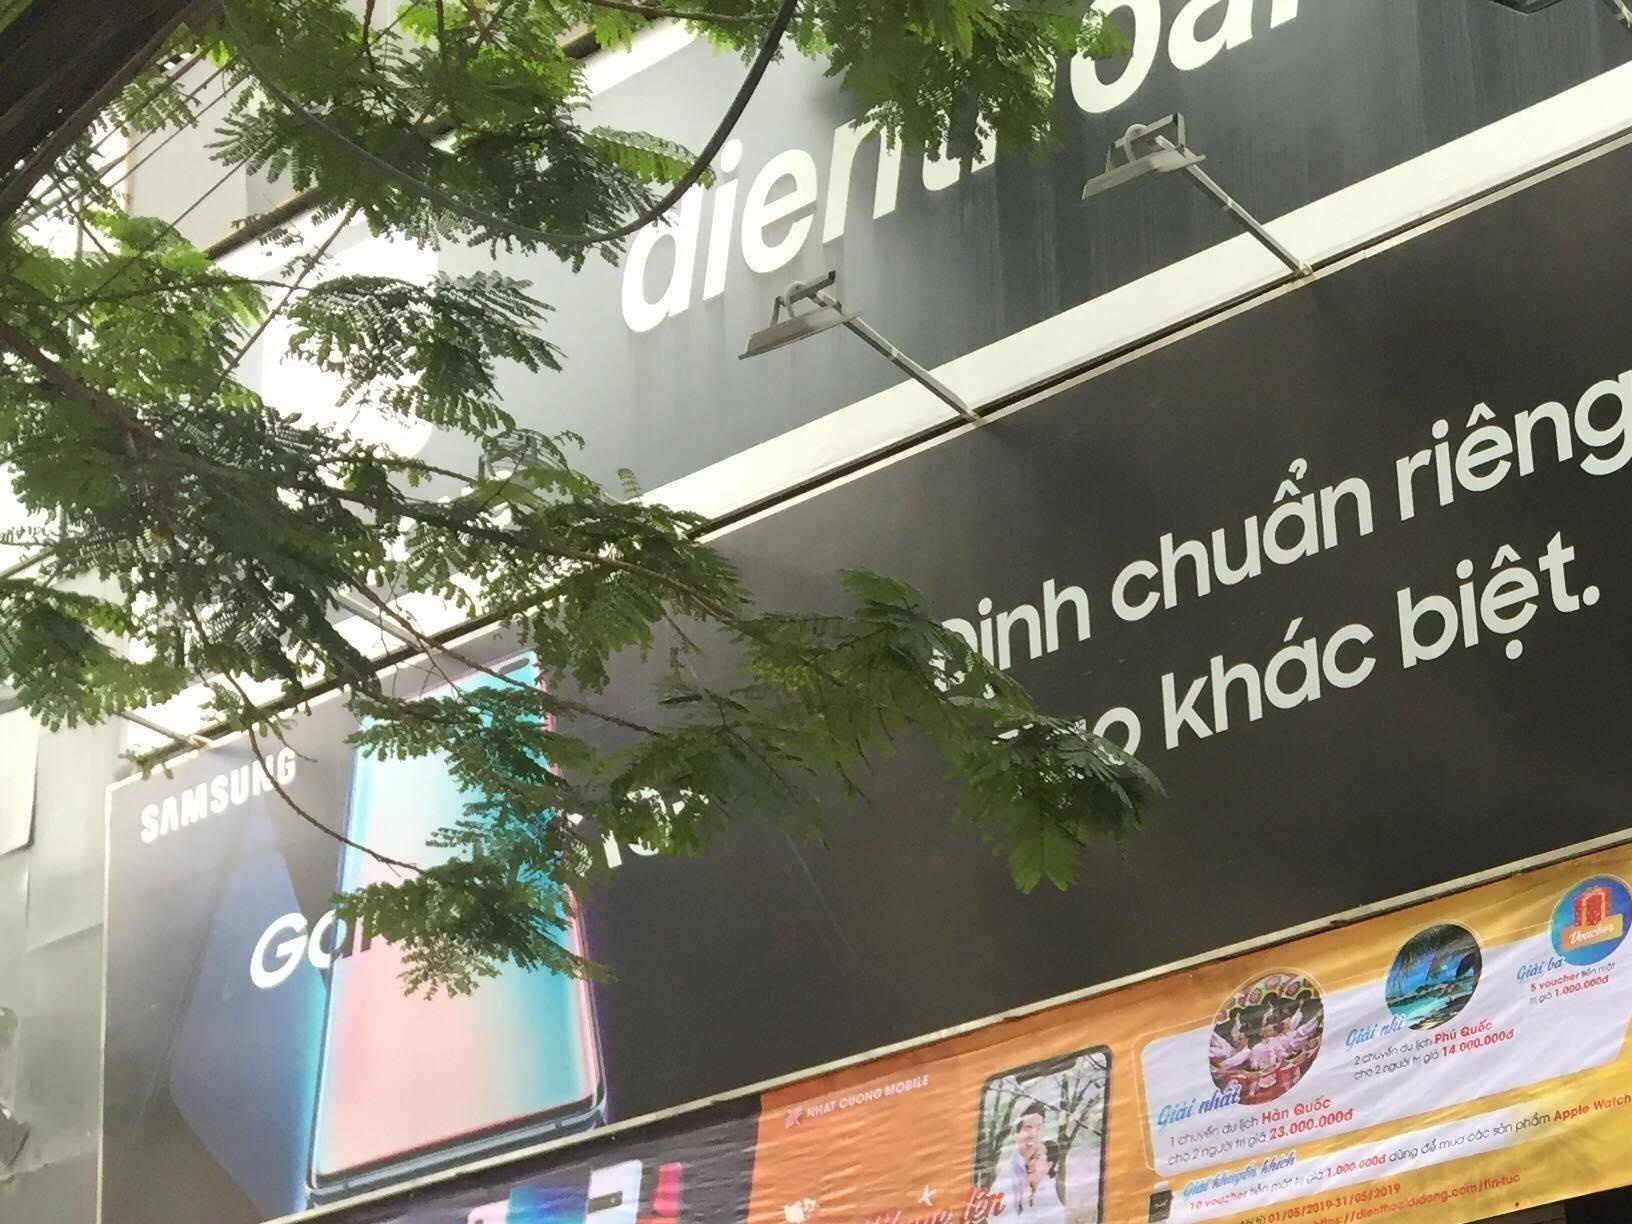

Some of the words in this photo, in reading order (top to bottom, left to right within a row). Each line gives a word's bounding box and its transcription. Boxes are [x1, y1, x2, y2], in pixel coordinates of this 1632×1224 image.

[1111, 457, 1375, 622] chuẩn
[1161, 617, 1376, 751] khác
[1397, 531, 1601, 670] biệt.
[140, 747, 297, 843] SAMSUNG
[884, 1074, 929, 1097] MOBILE
[1261, 1108, 1290, 1125] Hàn
[1293, 1094, 1332, 1116] Quốc
[1553, 1103, 1590, 1123] Apple
[1593, 1093, 1632, 1110] Watch
